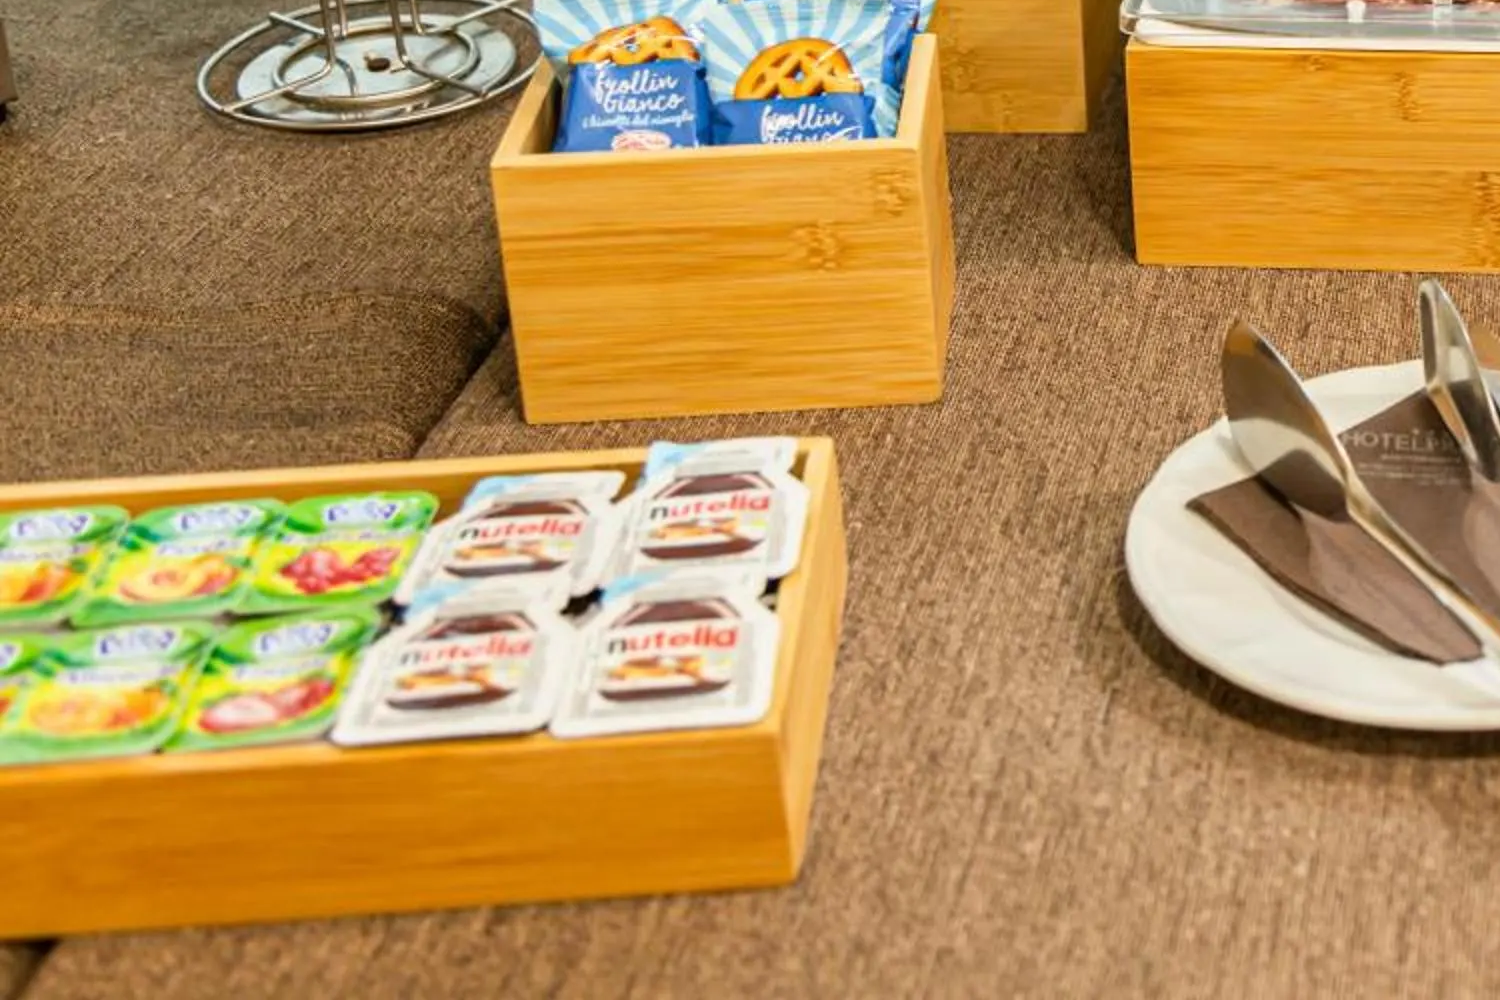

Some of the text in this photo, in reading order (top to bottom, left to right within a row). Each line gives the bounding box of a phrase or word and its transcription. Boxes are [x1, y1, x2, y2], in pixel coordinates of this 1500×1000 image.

[649, 492, 771, 521] nutella
[459, 517, 584, 540] nutella
[400, 633, 535, 666] nutella
[606, 623, 741, 655] nutella
